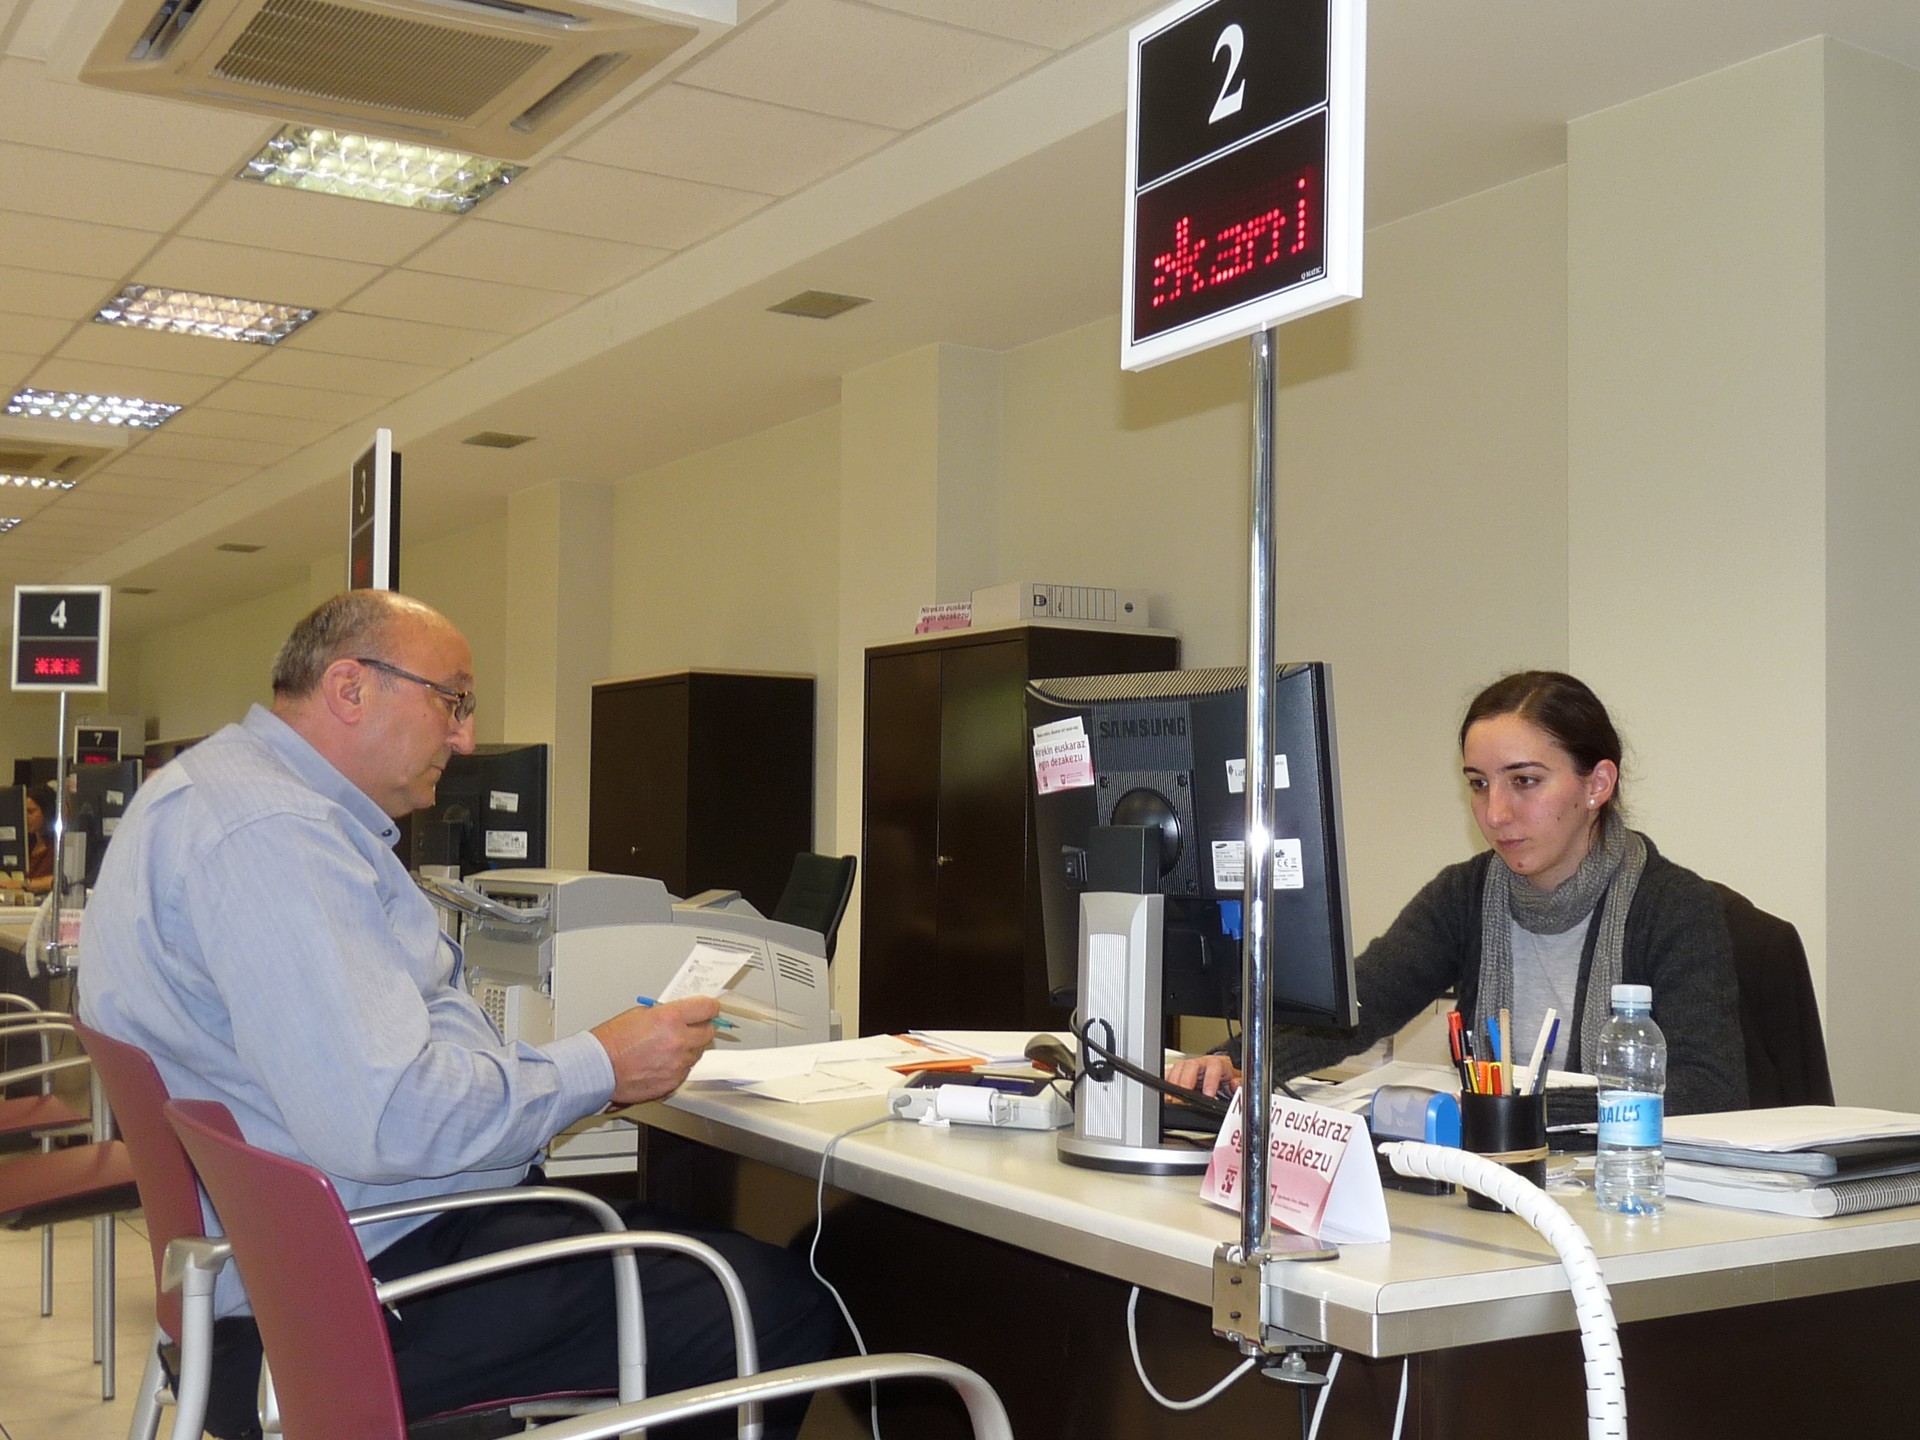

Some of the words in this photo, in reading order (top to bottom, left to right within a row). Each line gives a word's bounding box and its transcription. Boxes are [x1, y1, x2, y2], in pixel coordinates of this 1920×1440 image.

[1208, 23, 1246, 125] 2
[50, 599, 68, 630] 4
[1099, 717, 1187, 738] SAMSUNG
[94, 732, 103, 747] 7
[1054, 740, 1086, 754] euskaraz
[1050, 753, 1083, 767] dezakezu
[1284, 1110, 1353, 1143] euskaraz
